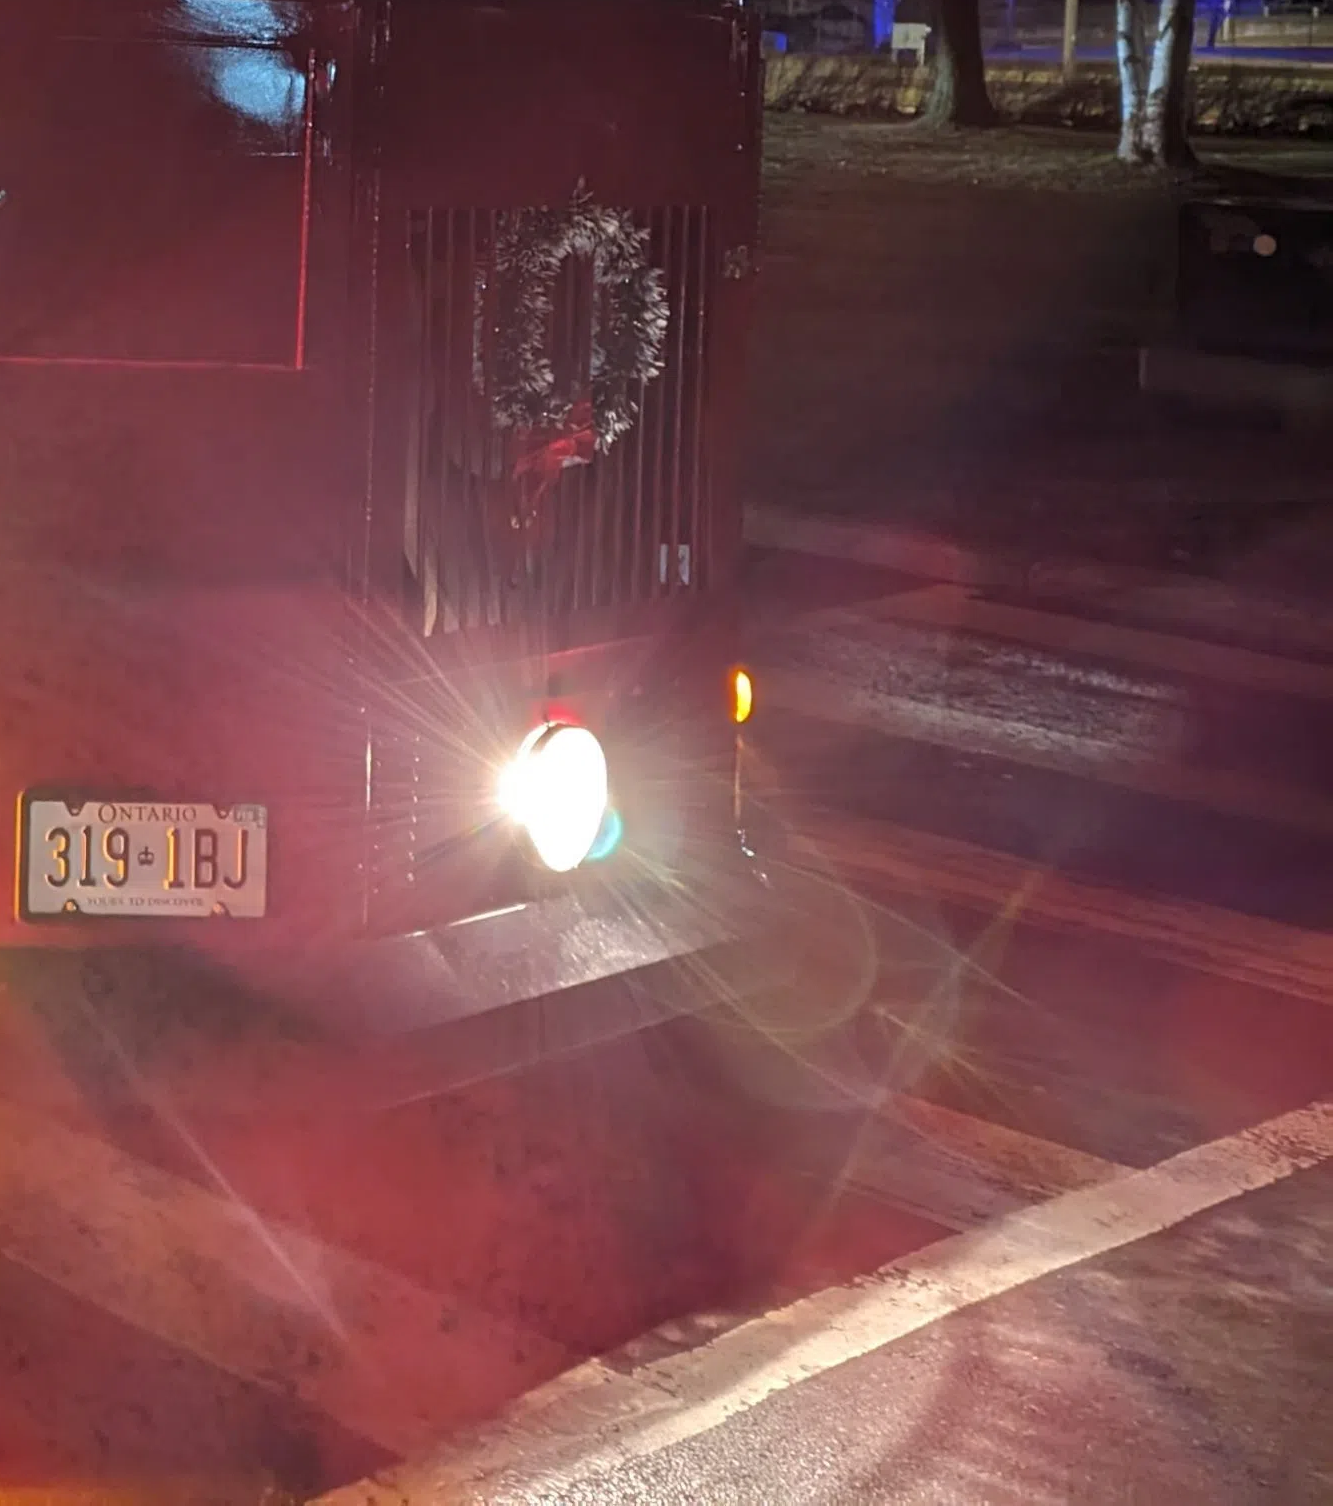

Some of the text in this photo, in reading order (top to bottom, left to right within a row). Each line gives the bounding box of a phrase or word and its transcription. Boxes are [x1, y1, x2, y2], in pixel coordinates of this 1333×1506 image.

[97, 803, 197, 824] ONTARIO
[44, 825, 249, 890] 319 1BJ
